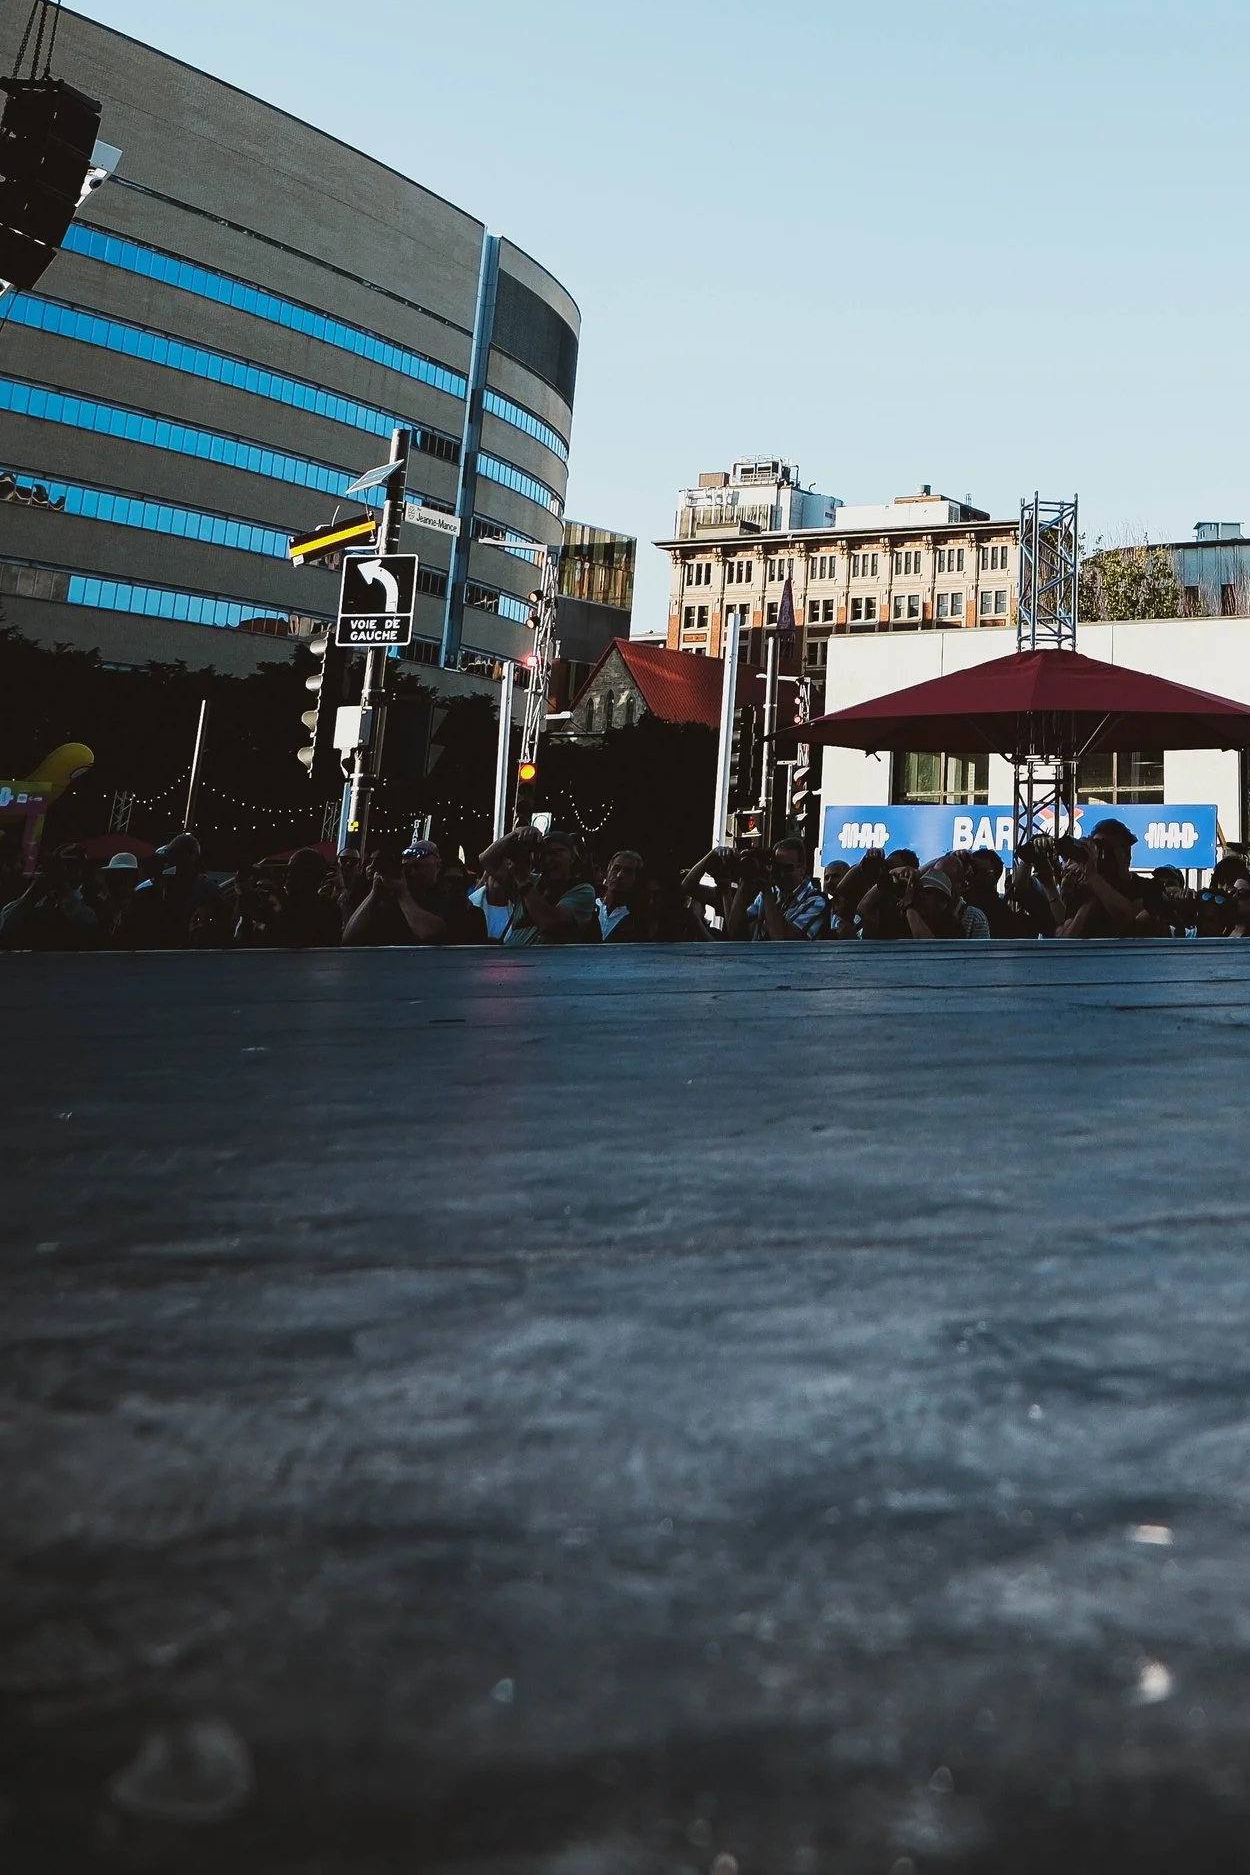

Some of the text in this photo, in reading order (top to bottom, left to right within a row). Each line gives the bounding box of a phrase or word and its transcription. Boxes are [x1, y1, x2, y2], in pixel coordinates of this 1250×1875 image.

[416, 512, 457, 532] Jeanne-Mance
[350, 619, 401, 629] VOIE DE
[350, 630, 398, 641] GAUCHE
[953, 816, 1015, 851] BAR
[1144, 823, 1198, 848] MAD
